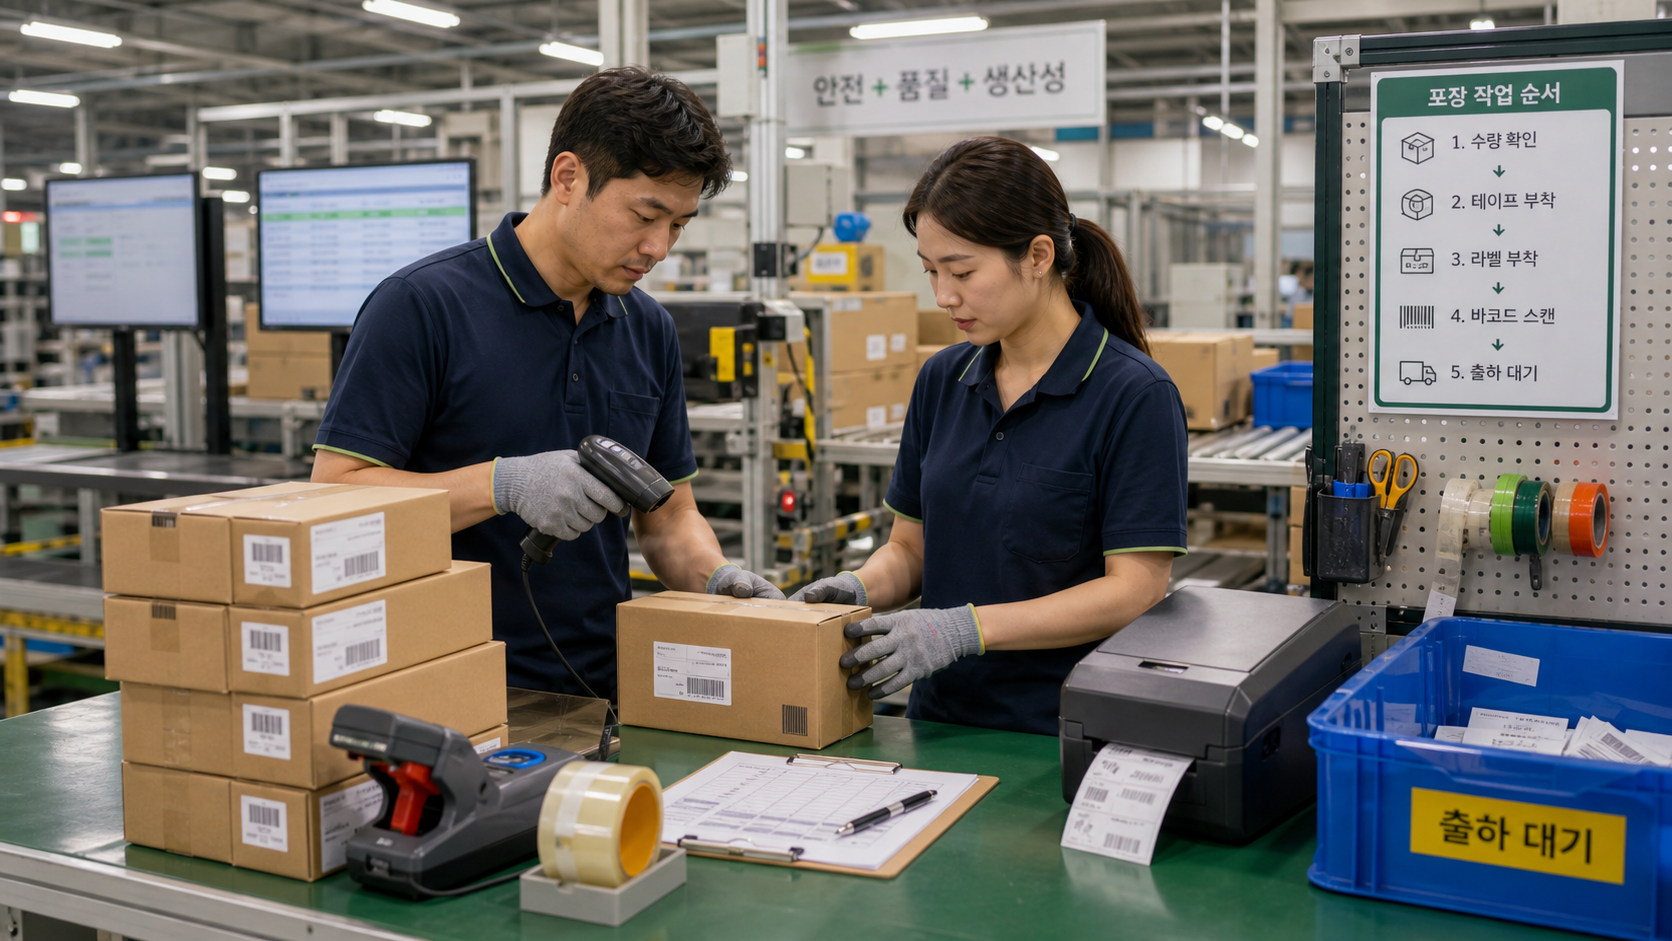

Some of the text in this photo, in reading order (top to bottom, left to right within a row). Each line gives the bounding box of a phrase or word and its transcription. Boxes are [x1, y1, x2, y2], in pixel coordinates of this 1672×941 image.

[813, 74, 864, 107] 안전
[898, 67, 949, 102] 품질
[983, 61, 1065, 98] 생산성
[1427, 81, 1561, 108] 포장 작업 순서
[1452, 130, 1537, 150] 1. 수량 확인
[1451, 191, 1557, 211] 2. 테이프 부착
[1451, 249, 1539, 268] 3. 라벨 부착
[1450, 307, 1555, 325] 4. 바코드 스캔
[1450, 363, 1538, 383] 5. 출하 대기
[1439, 808, 1593, 865] 출하 대기
